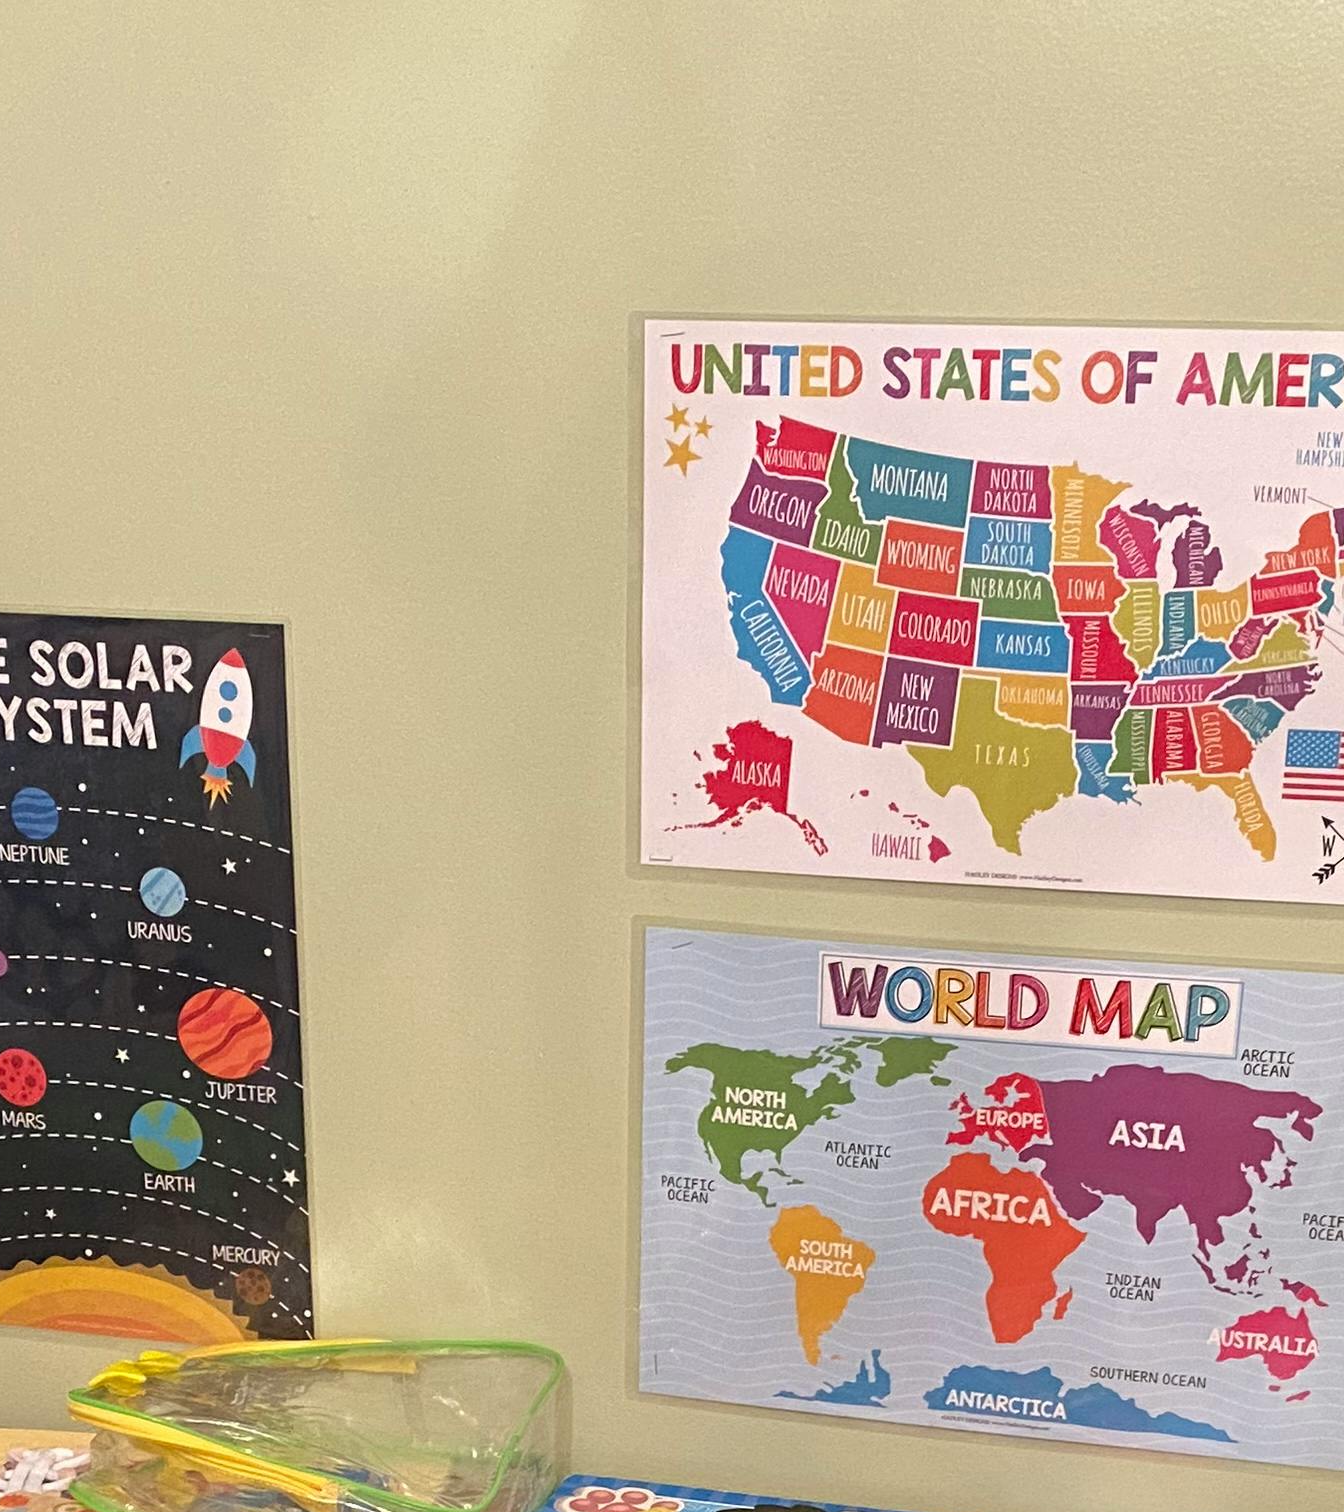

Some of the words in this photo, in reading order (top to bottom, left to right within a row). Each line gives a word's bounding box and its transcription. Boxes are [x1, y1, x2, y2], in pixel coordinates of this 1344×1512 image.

[671, 343, 863, 397] UNITED
[882, 347, 1062, 403] STATES
[1081, 350, 1158, 405] OF
[1317, 432, 1344, 449] NEW
[870, 463, 948, 502] MONTANA
[990, 468, 1034, 491] NORTH
[749, 484, 813, 530] OREGON
[983, 491, 1037, 513] DAKOTA
[1254, 486, 1308, 504] VERMONT
[1060, 479, 1084, 560] MINNESOTA
[821, 518, 870, 558] IDAHO
[987, 522, 1031, 545] SOUTH
[1108, 514, 1150, 577] WISCONSIN
[886, 538, 956, 574] WYOMING
[981, 545, 1034, 567] DAKOTA
[1188, 526, 1205, 586] MICHIGAN
[1272, 555, 1298, 571] NEW
[1300, 548, 1331, 569] YORK
[769, 566, 830, 608] NEVADA
[970, 577, 1042, 600] NEBRASKA
[1066, 578, 1106, 600] IOWA
[841, 592, 886, 633] UTAH
[1169, 596, 1185, 650] INDIANA
[1200, 598, 1241, 627] OHIO
[897, 611, 971, 647] COLORADO
[739, 600, 804, 693] CALIFORNIA
[995, 633, 1051, 657] KANSAS
[1080, 620, 1101, 680] MISSOURI
[28, 639, 195, 695] SOLAR
[1160, 658, 1215, 675] KENTUCKY
[816, 668, 876, 706] ARIZONA
[900, 673, 934, 701] NEW
[1001, 686, 1064, 706] OKLAHOMA
[1139, 684, 1204, 703] TENNESSEE
[1073, 693, 1122, 711] ARKANSAS
[885, 702, 939, 735] MEXICO
[1166, 710, 1184, 770] ALABAMA
[1200, 711, 1224, 770] GEORGIA
[975, 744, 1031, 768] TEXAS
[732, 760, 782, 788] ALASKA
[1233, 781, 1264, 832] FLORIDA
[871, 832, 922, 861] HAWAII
[126, 920, 193, 943] URANUS
[827, 961, 1050, 1031] WORLD
[1068, 978, 1230, 1042] MAP
[1240, 1049, 1295, 1065] ARCTIC
[1243, 1064, 1291, 1078] OCEAN
[204, 1080, 278, 1105] JUPITER
[725, 1086, 787, 1109] NORTH
[1, 1110, 47, 1131] MARS
[710, 1107, 798, 1131] AMERICA
[975, 1110, 1045, 1131] EUROPE
[1108, 1120, 1186, 1152] ASIA
[824, 1141, 892, 1158] ATLANTIC
[835, 1156, 880, 1170] OCEAN
[143, 1173, 197, 1193] EARTH
[660, 1175, 716, 1192] PACIFIC
[667, 1190, 709, 1204] OCEAN
[930, 1188, 1052, 1227] AFRICA
[212, 1244, 281, 1267] MERCURY
[799, 1239, 853, 1259] SOUTH
[785, 1258, 865, 1279] AMERICA
[1105, 1272, 1162, 1289] INDIAN
[1109, 1287, 1154, 1301] OCEAN
[1207, 1328, 1320, 1357] AUSTRALIA
[1090, 1366, 1160, 1385] SOUTHERN
[1162, 1372, 1207, 1389] OCEAN
[944, 1388, 1067, 1421] ANTARCTICA
